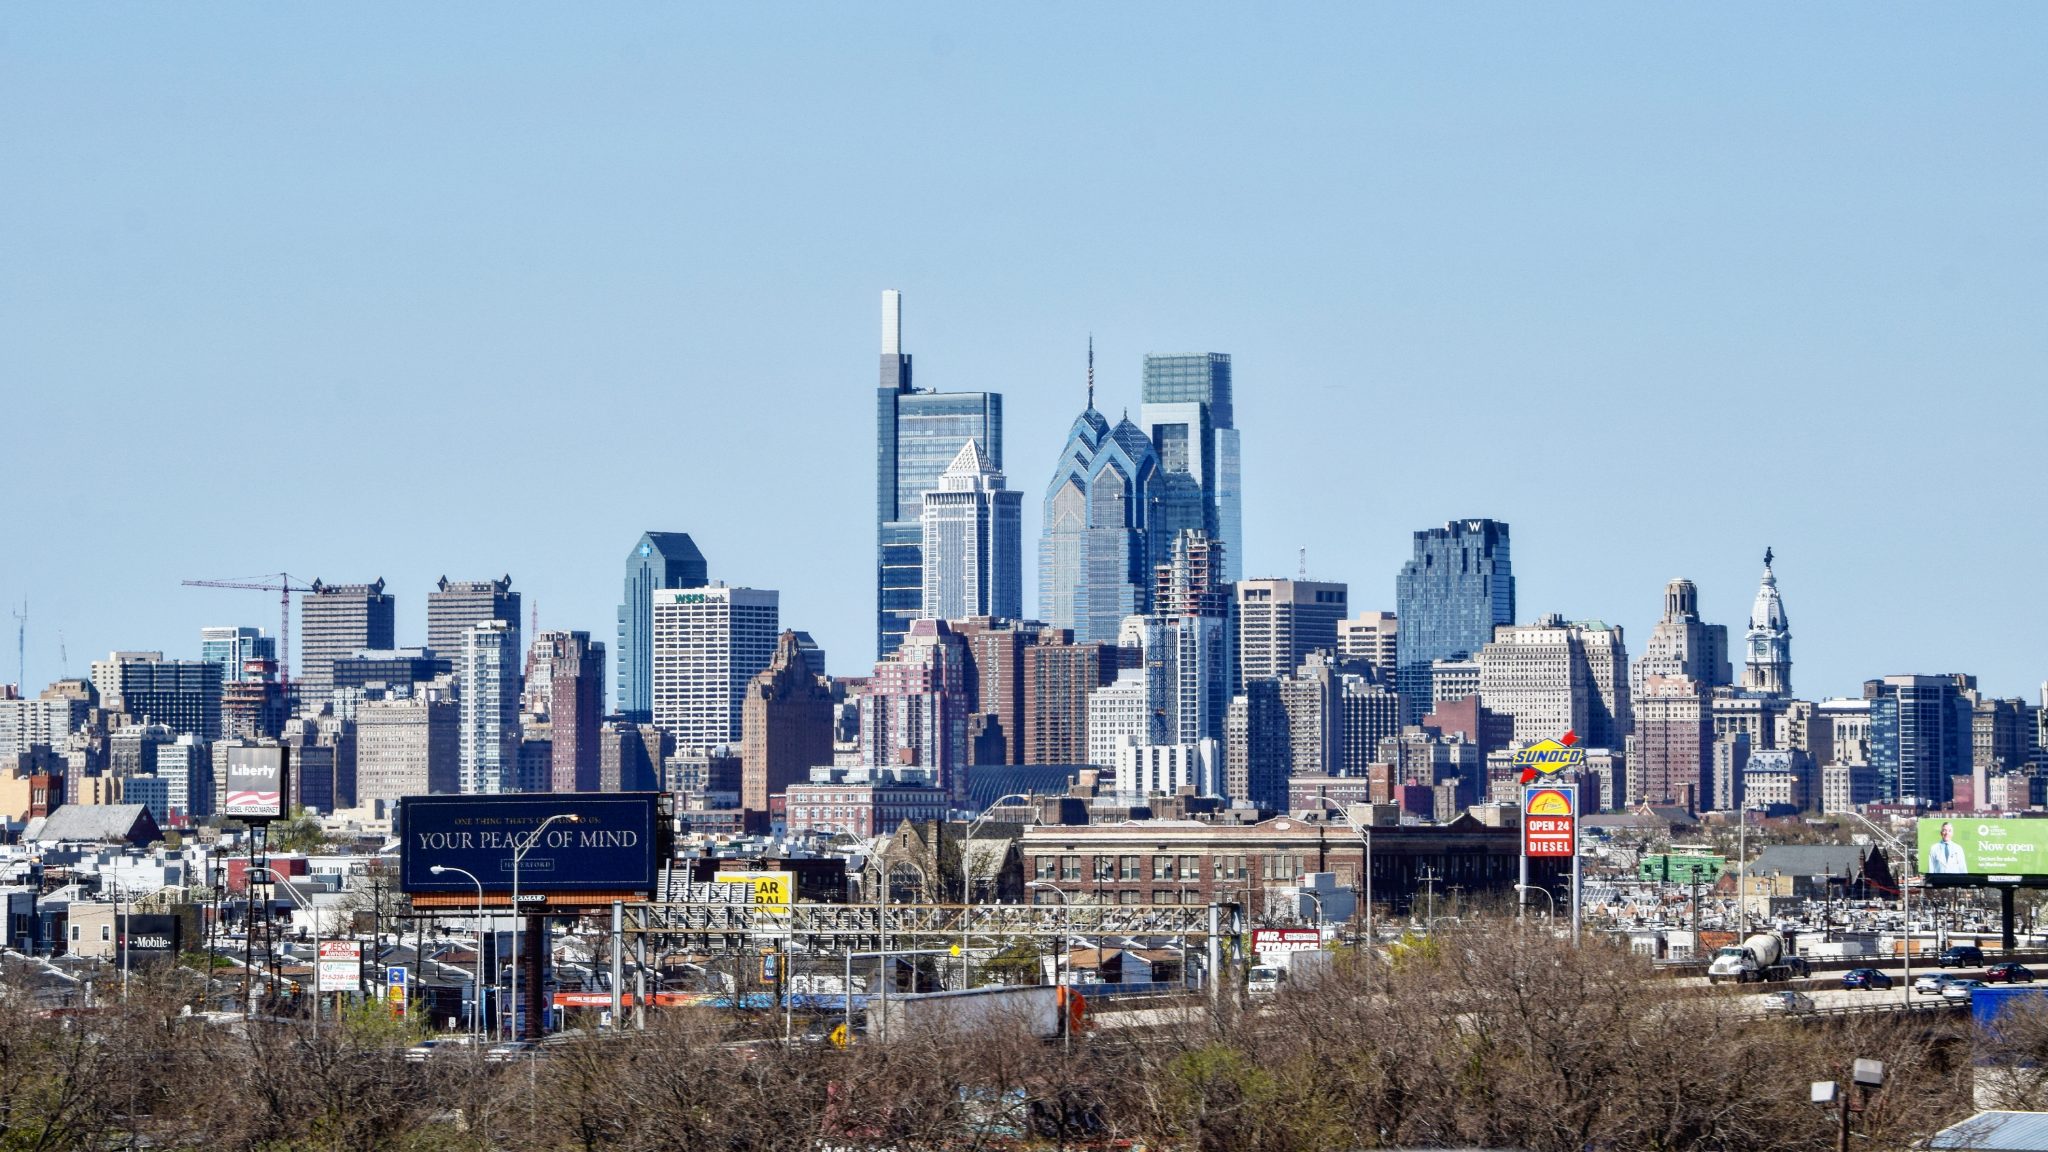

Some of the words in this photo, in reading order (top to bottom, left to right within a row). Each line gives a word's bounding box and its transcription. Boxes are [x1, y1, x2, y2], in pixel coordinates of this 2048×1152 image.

[1469, 521, 1481, 532] W
[675, 594, 705, 604] WSFS
[705, 594, 727, 603] bank
[1515, 751, 1581, 762] SUNOCO
[231, 764, 276, 778] Liberty
[1530, 820, 1555, 831] OPEN
[1557, 820, 1570, 831] 24
[419, 832, 475, 850] YOUR
[480, 831, 541, 849] PEACE
[547, 831, 573, 848] OF
[580, 830, 638, 848] MIND
[1530, 841, 1570, 852] DIESEL
[1978, 841, 2004, 851] Now
[2006, 844, 2034, 854] open
[1257, 931, 1283, 941] MR.
[329, 942, 351, 951] JEFCO
[1255, 942, 1319, 952] STORAGE
